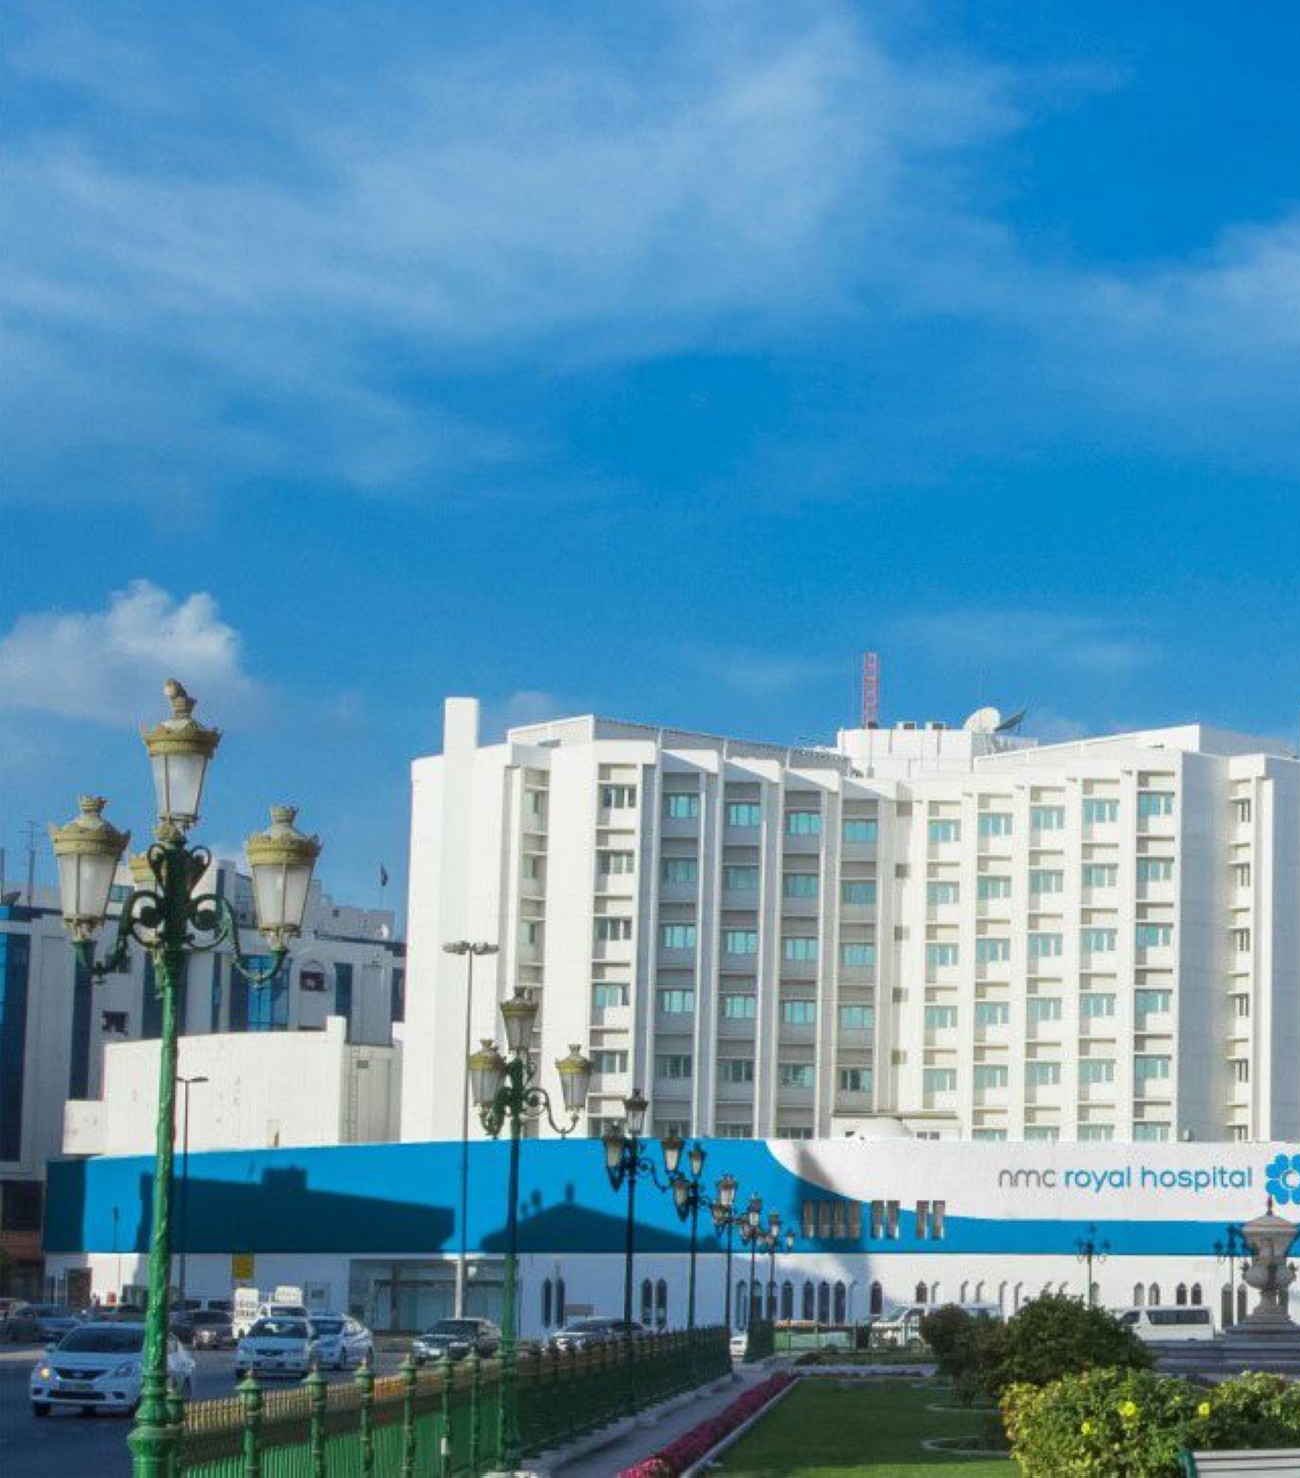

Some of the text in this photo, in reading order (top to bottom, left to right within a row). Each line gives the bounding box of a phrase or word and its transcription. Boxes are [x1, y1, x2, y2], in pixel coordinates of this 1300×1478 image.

[997, 1165, 1253, 1193] nmc royal hospital
